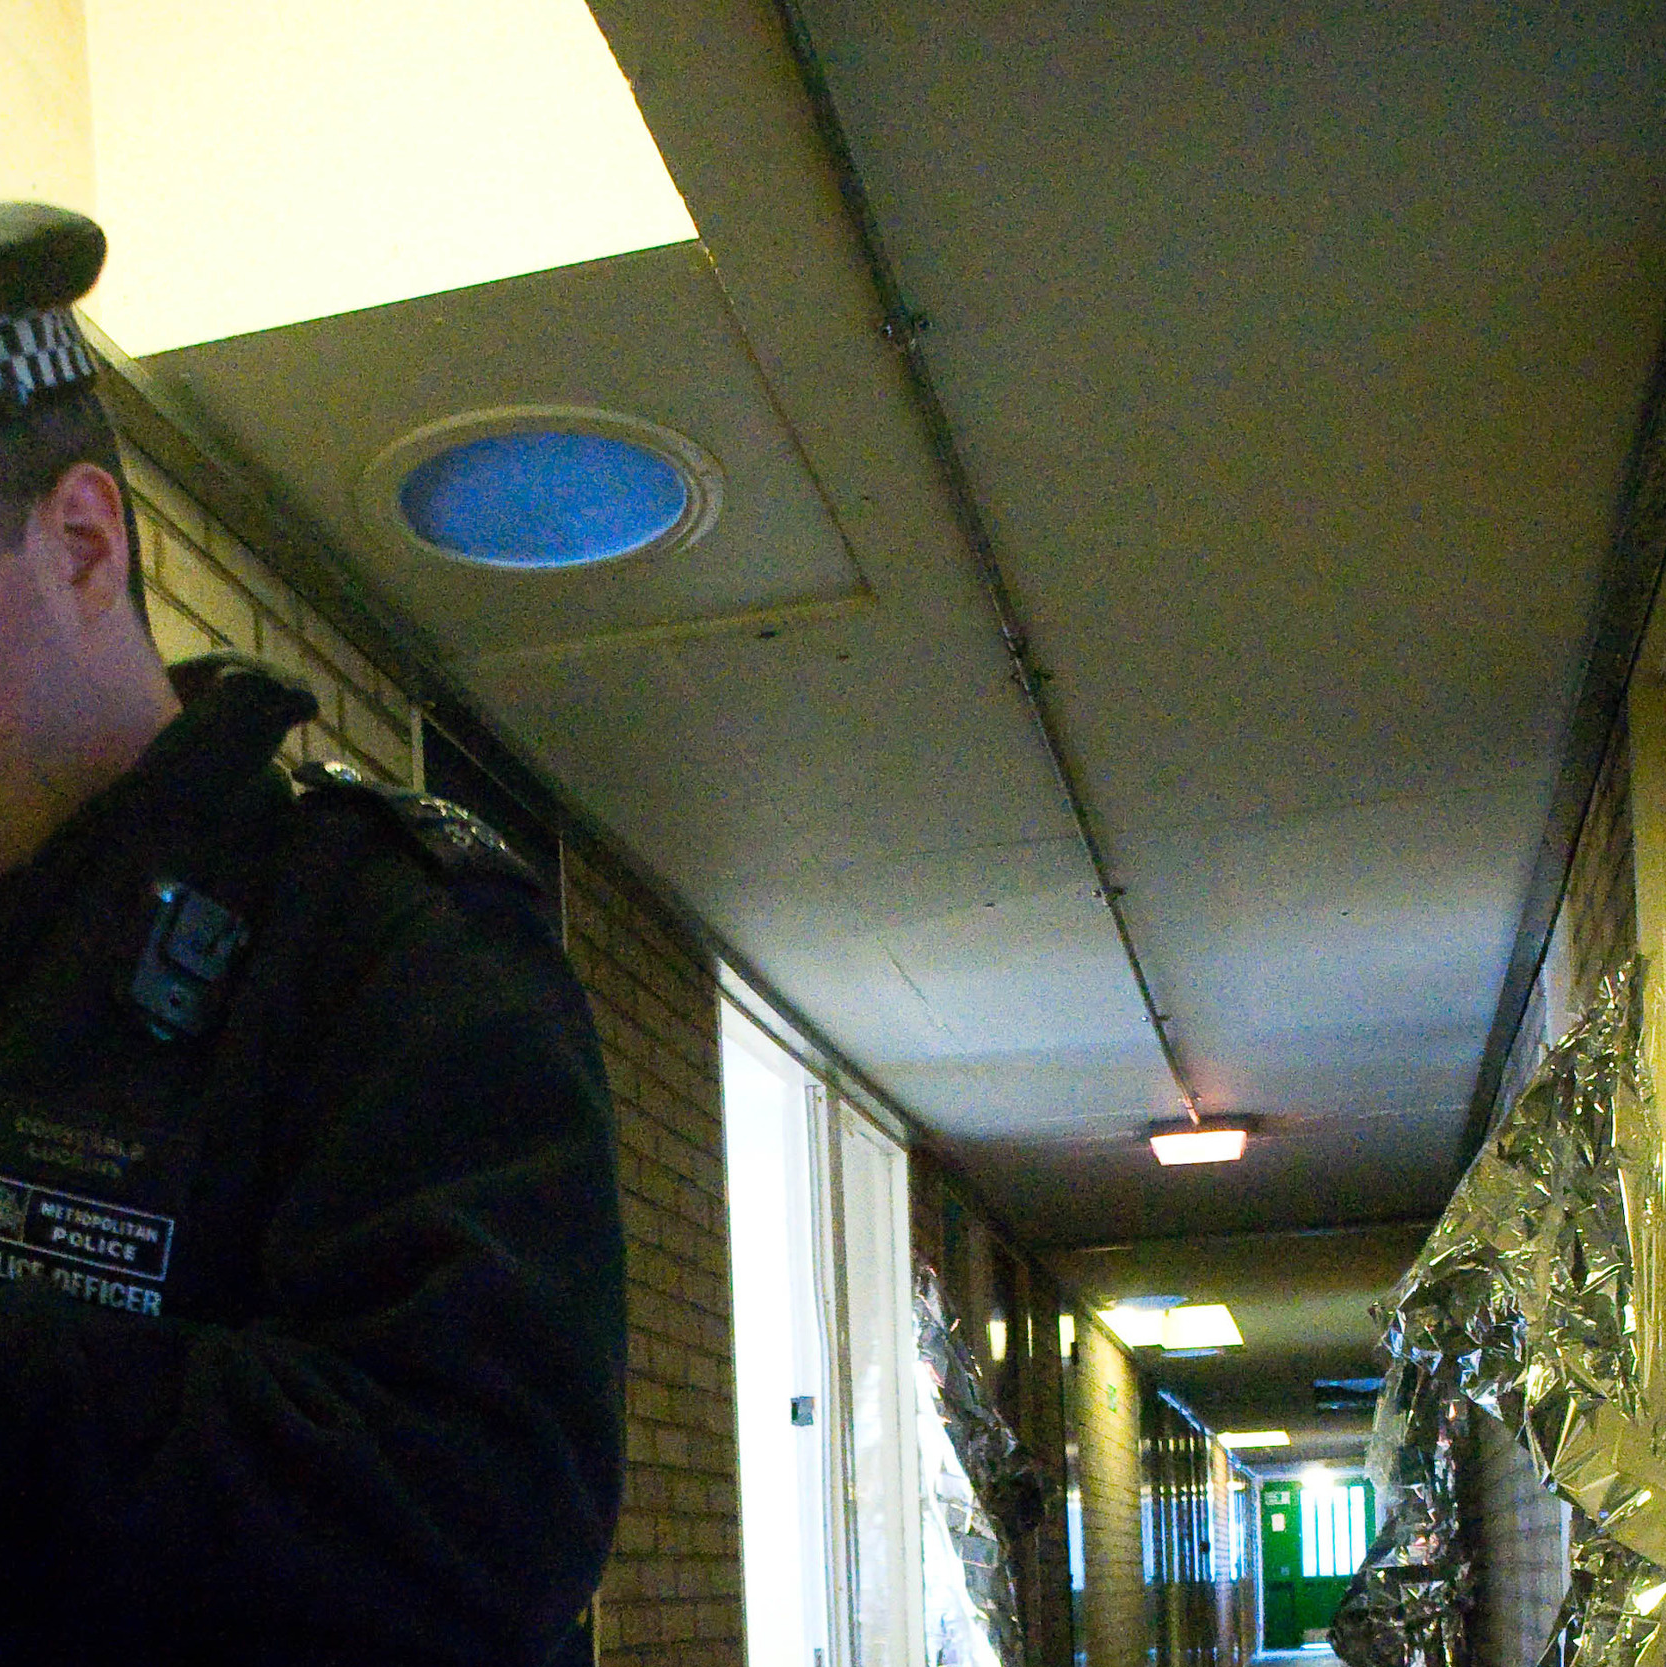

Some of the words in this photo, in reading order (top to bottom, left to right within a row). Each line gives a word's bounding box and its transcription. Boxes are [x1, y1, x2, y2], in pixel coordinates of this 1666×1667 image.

[40, 1201, 159, 1243] METROPOLITAN
[51, 1225, 138, 1262] POLICE
[52, 1267, 163, 1317] OFFICER
